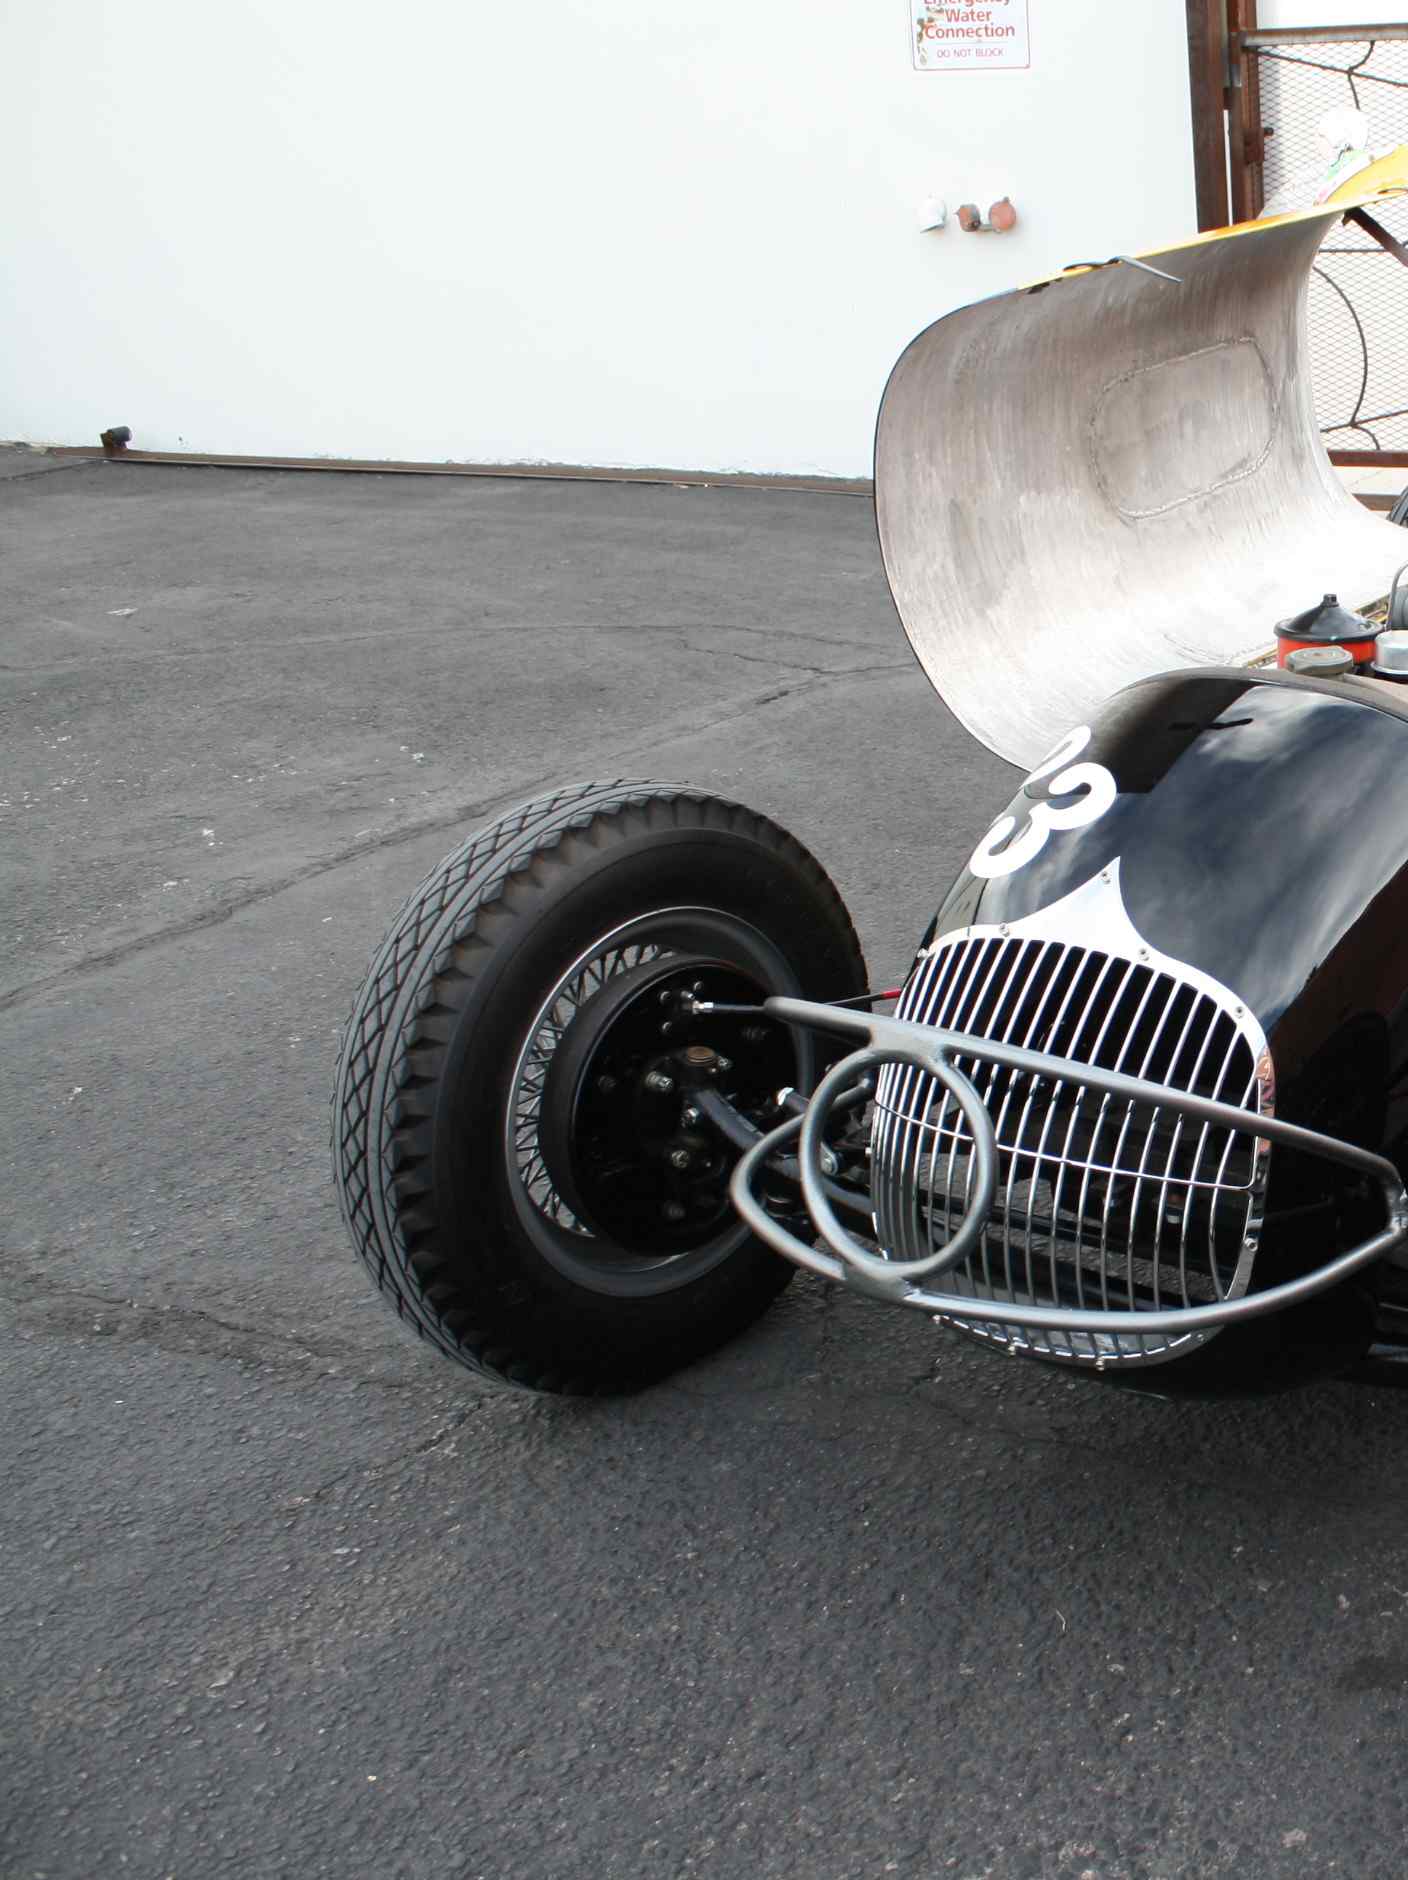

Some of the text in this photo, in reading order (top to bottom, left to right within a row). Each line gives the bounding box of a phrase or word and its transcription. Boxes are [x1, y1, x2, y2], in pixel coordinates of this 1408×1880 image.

[945, 8, 992, 22] Water
[925, 23, 1015, 39] Connection
[953, 48, 971, 57] NOT
